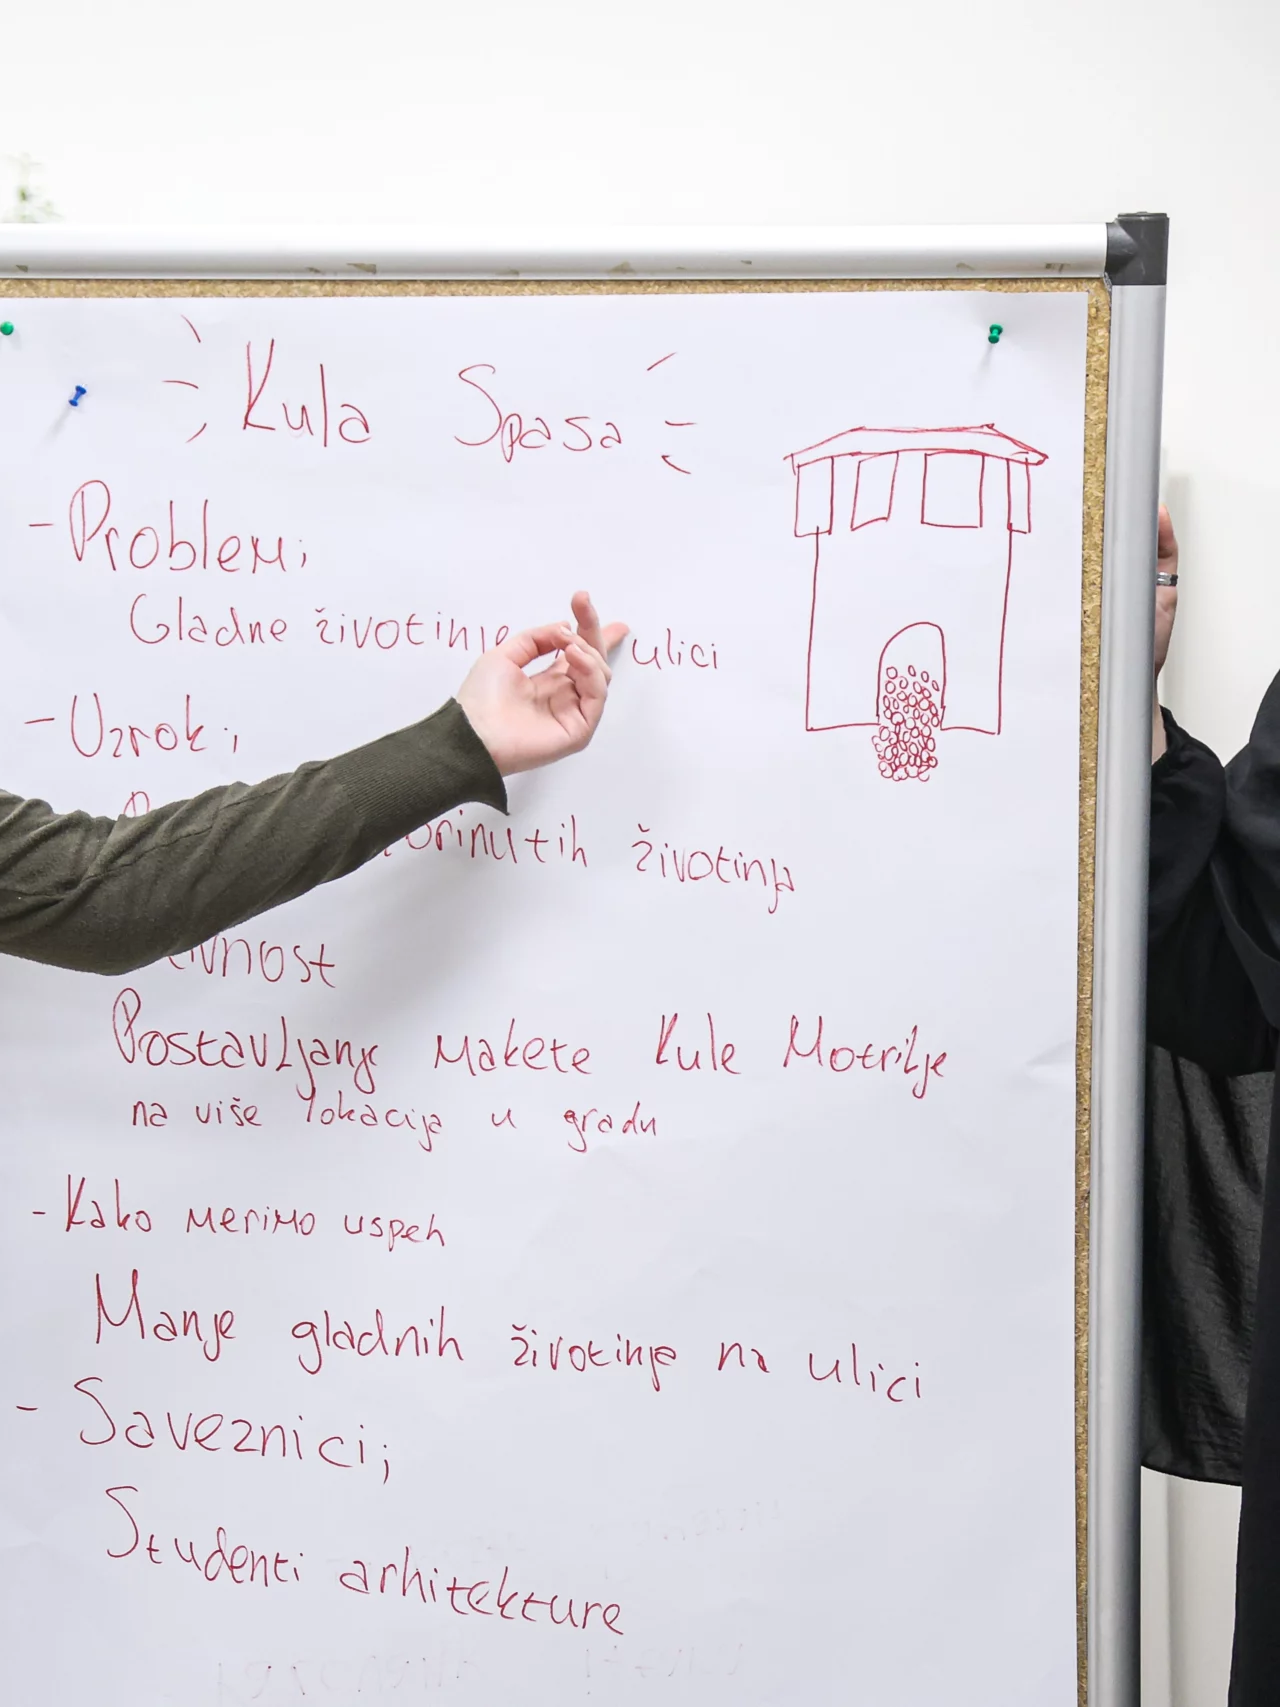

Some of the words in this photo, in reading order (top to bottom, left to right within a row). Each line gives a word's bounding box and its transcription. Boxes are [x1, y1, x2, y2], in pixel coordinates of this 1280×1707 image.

[242, 340, 370, 447] Kula
[457, 364, 622, 464] Spasa
[130, 594, 288, 647] Gladne
[631, 627, 718, 670] ulici
[632, 823, 796, 914] životinja
[655, 1012, 740, 1075] Kule
[132, 1100, 169, 1128] na
[195, 1097, 262, 1128] više
[305, 1087, 442, 1152] lokacija
[491, 1108, 517, 1129] u
[563, 1101, 657, 1153] gradu
[65, 1175, 153, 1233] Kako
[343, 1214, 446, 1251] uspeh
[96, 1268, 235, 1362] Manje
[292, 1306, 464, 1376] gladnih
[511, 1324, 678, 1392] životinje
[718, 1342, 770, 1373] na
[809, 1343, 921, 1403] ulici
[105, 1485, 304, 1587] Studenti
[339, 1546, 623, 1635] arhitekture
